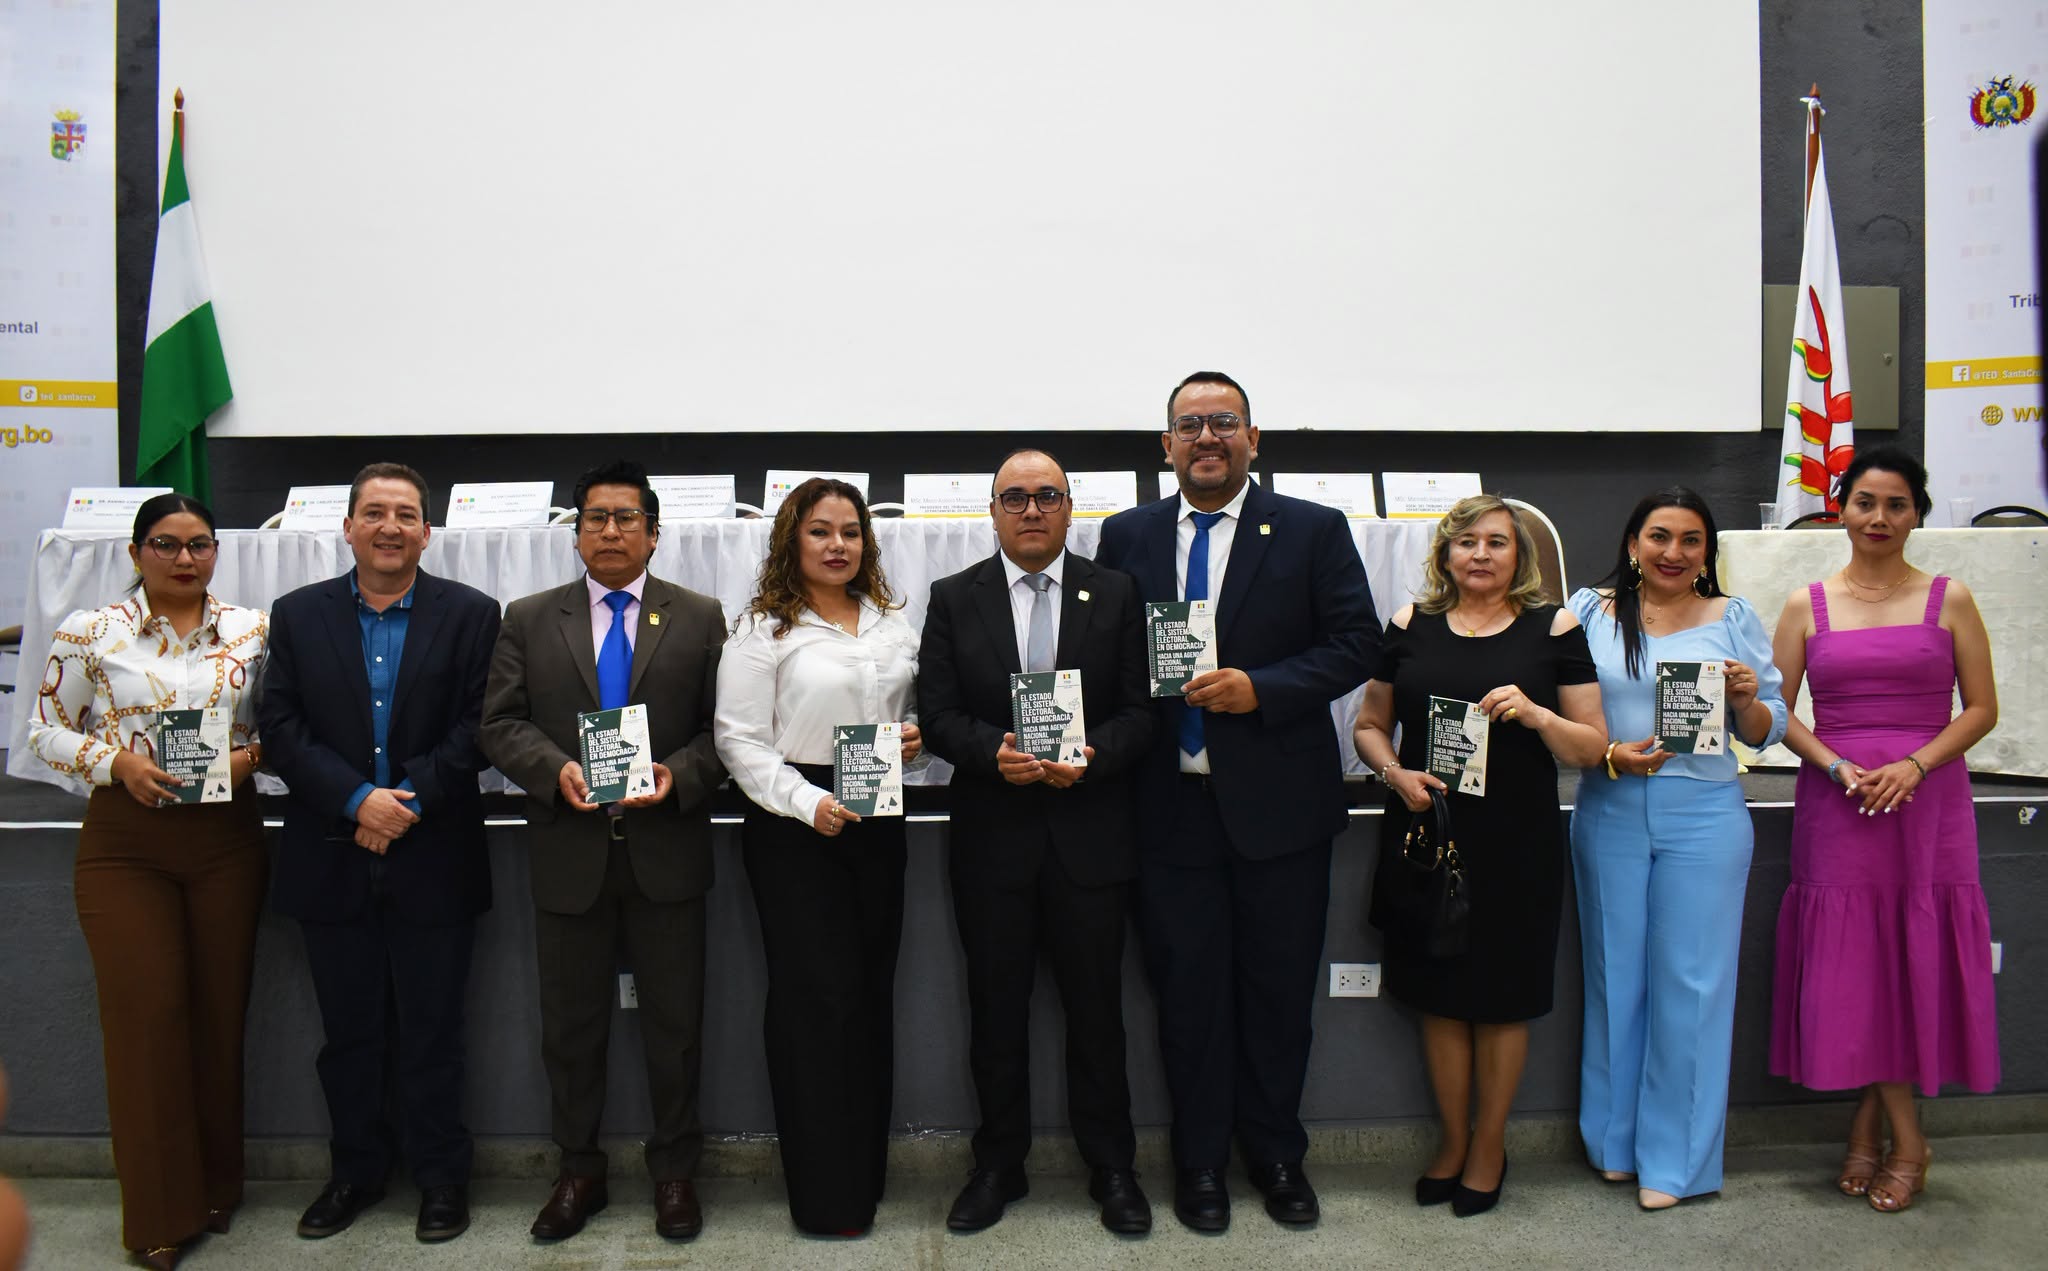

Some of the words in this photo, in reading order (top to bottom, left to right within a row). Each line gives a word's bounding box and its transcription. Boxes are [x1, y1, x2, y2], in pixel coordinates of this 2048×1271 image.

[1022, 708, 1055, 716] ELECTORAL
[1442, 719, 1462, 727] ESTADO
[174, 729, 198, 737] ESTADO
[596, 729, 618, 738] ESTADO
[1435, 731, 1462, 741] ELECTORAL
[600, 735, 624, 744] SISTEMA
[589, 742, 622, 753] ELECTORAL
[1433, 753, 1454, 761] NACIONAL
[591, 766, 616, 774] NACIONAL
[1439, 766, 1455, 774] BOLIVIA
[599, 771, 622, 779] REFORMA
[600, 778, 619, 786] BOLIVIA
